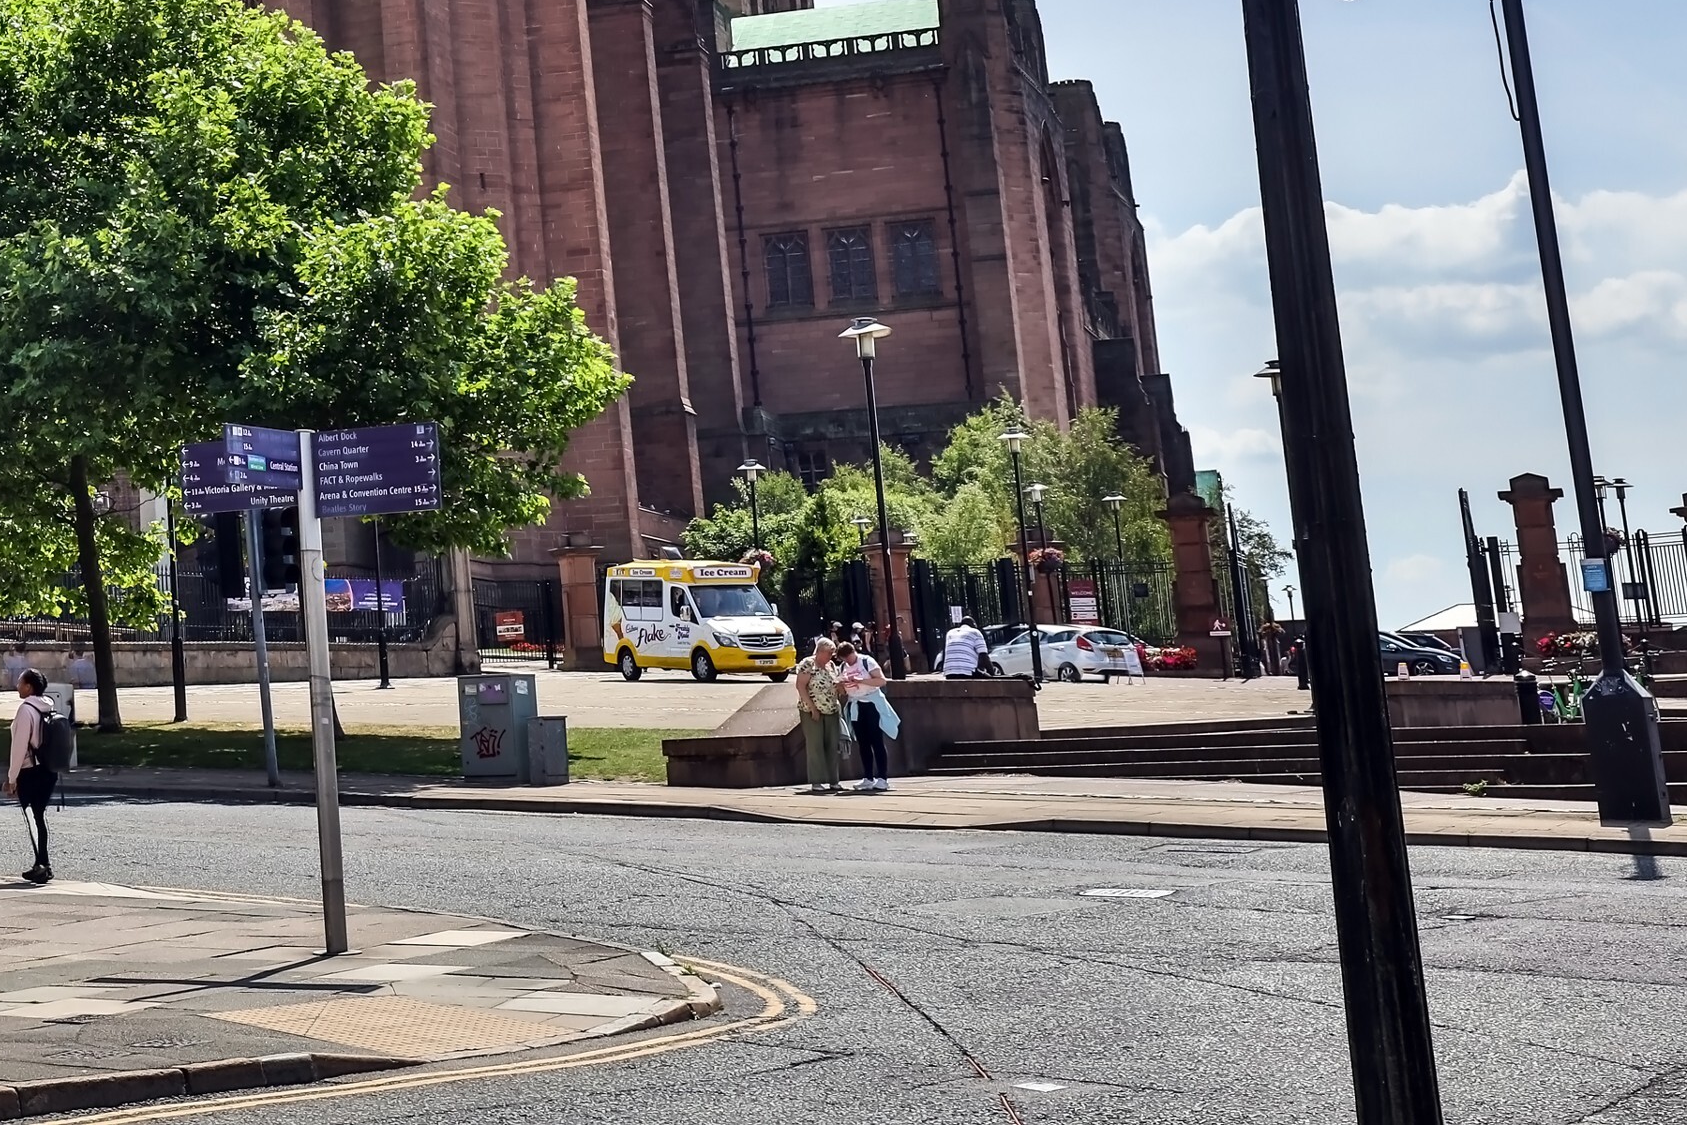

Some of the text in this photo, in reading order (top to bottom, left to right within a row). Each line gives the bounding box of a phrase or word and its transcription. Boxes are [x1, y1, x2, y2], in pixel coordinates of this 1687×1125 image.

[318, 432, 357, 443] Albert Dock
[410, 440, 418, 448] 14
[318, 445, 370, 457] Cavern Quarter
[269, 461, 284, 470] Central
[284, 462, 298, 472] Station
[318, 460, 359, 471] China Town
[320, 472, 383, 485] FACT & Ropewalks
[204, 485, 230, 495] Victoria
[231, 483, 255, 494] Gallery
[319, 485, 421, 500] Arena & Convention Centre 15
[250, 495, 295, 507] Unity Theatre
[415, 498, 422, 506] 15
[322, 503, 367, 514] Beatles Story
[716, 568, 747, 576] Cream
